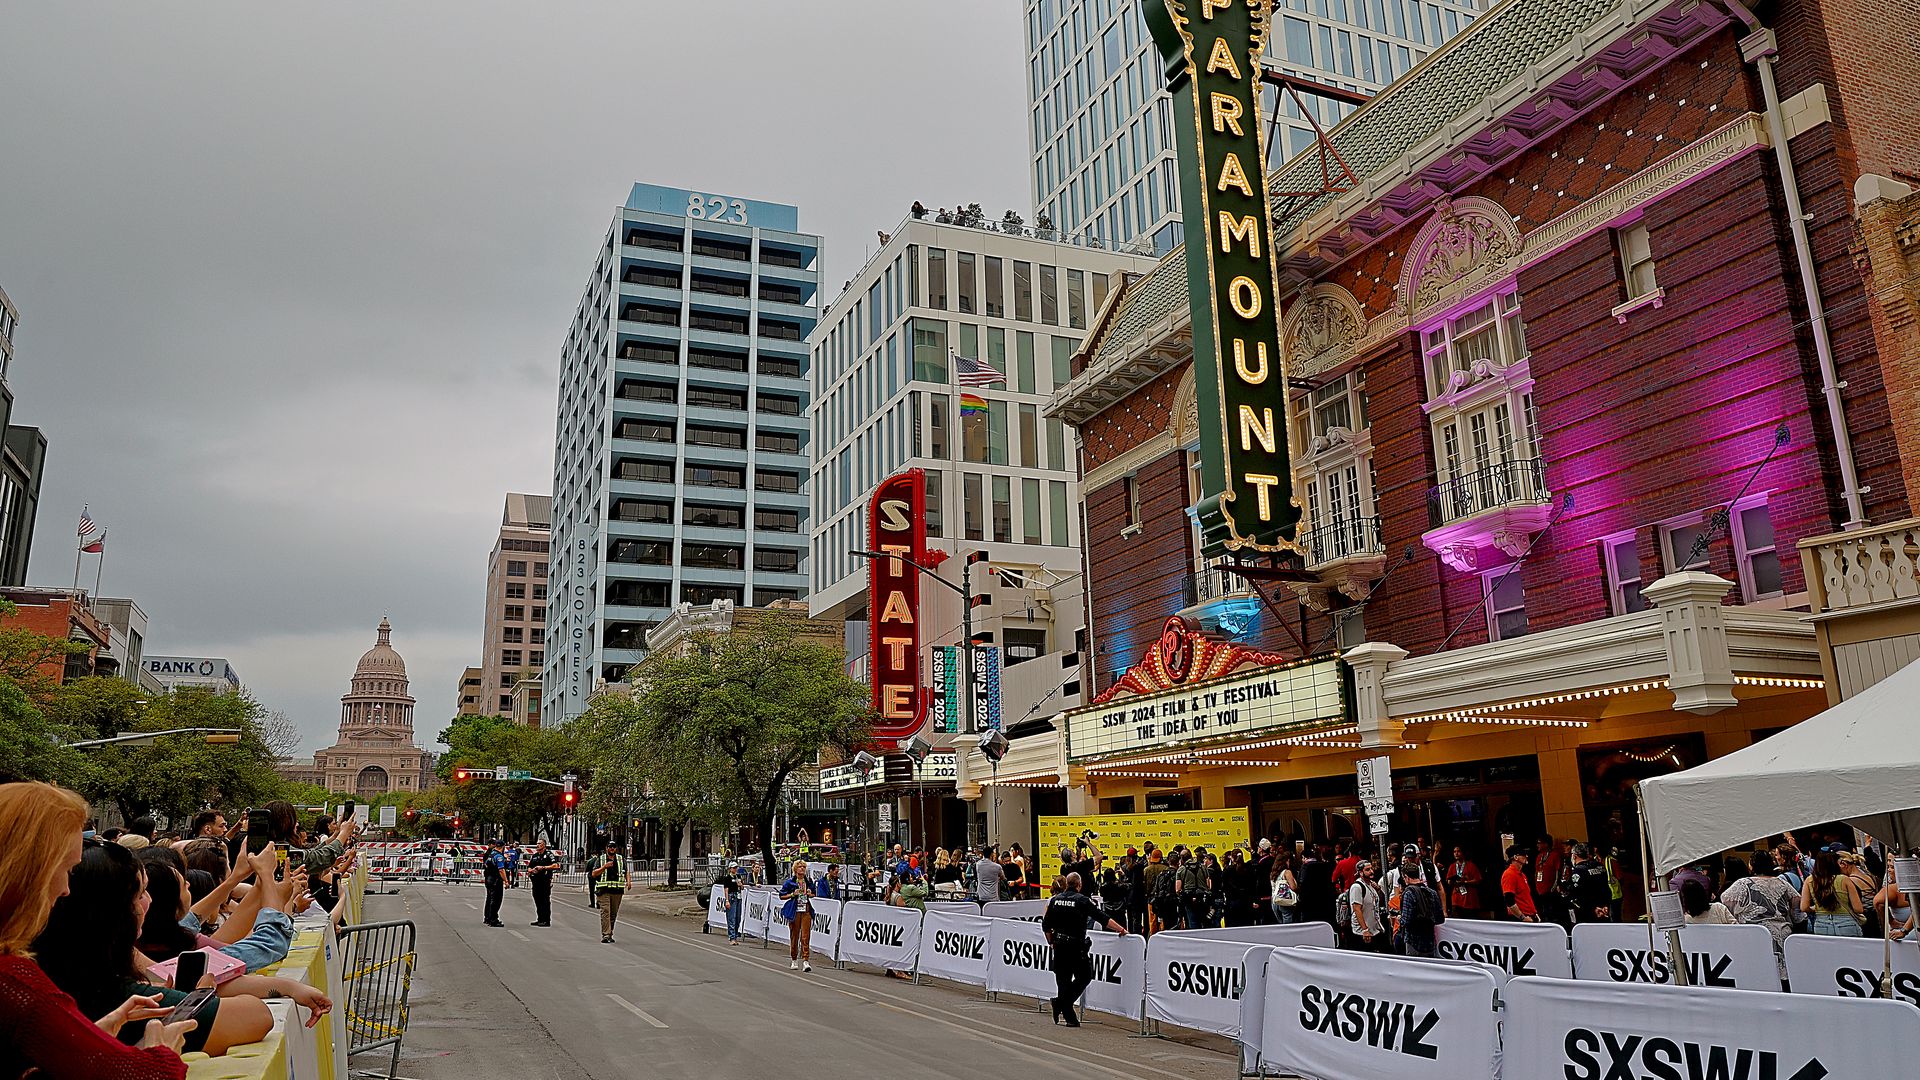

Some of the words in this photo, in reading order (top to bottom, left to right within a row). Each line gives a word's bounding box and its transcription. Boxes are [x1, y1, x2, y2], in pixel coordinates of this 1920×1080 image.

[686, 193, 748, 225] 823
[576, 539, 585, 578] 823
[880, 500, 914, 719] STATE
[571, 585, 585, 697] CONGRESS
[150, 661, 195, 673] BANK
[933, 651, 944, 683] SXSW
[976, 652, 986, 683] SXSW
[934, 698, 945, 728] 2024
[977, 698, 988, 728] 2024
[1102, 711, 1126, 729] SXSW
[1132, 705, 1155, 723] 2024
[1162, 699, 1186, 717] FILM
[1192, 697, 1198, 711] &
[1203, 692, 1217, 709] TV
[1224, 680, 1280, 705] FESTIVAL
[1137, 724, 1155, 740] THE
[1163, 720, 1188, 737] IDEA
[1194, 715, 1207, 731] OF
[1217, 709, 1238, 727] YOU
[933, 755, 957, 765] SXS
[934, 767, 957, 776] 202
[1054, 899, 1076, 908] POLICE
[855, 920, 892, 946] SXSW
[934, 930, 973, 958] SXSW
[1003, 940, 1048, 971] SXSW
[1438, 940, 1509, 973] SXSW
[1168, 961, 1231, 999] SXSW
[1300, 985, 1401, 1051] SXSW
